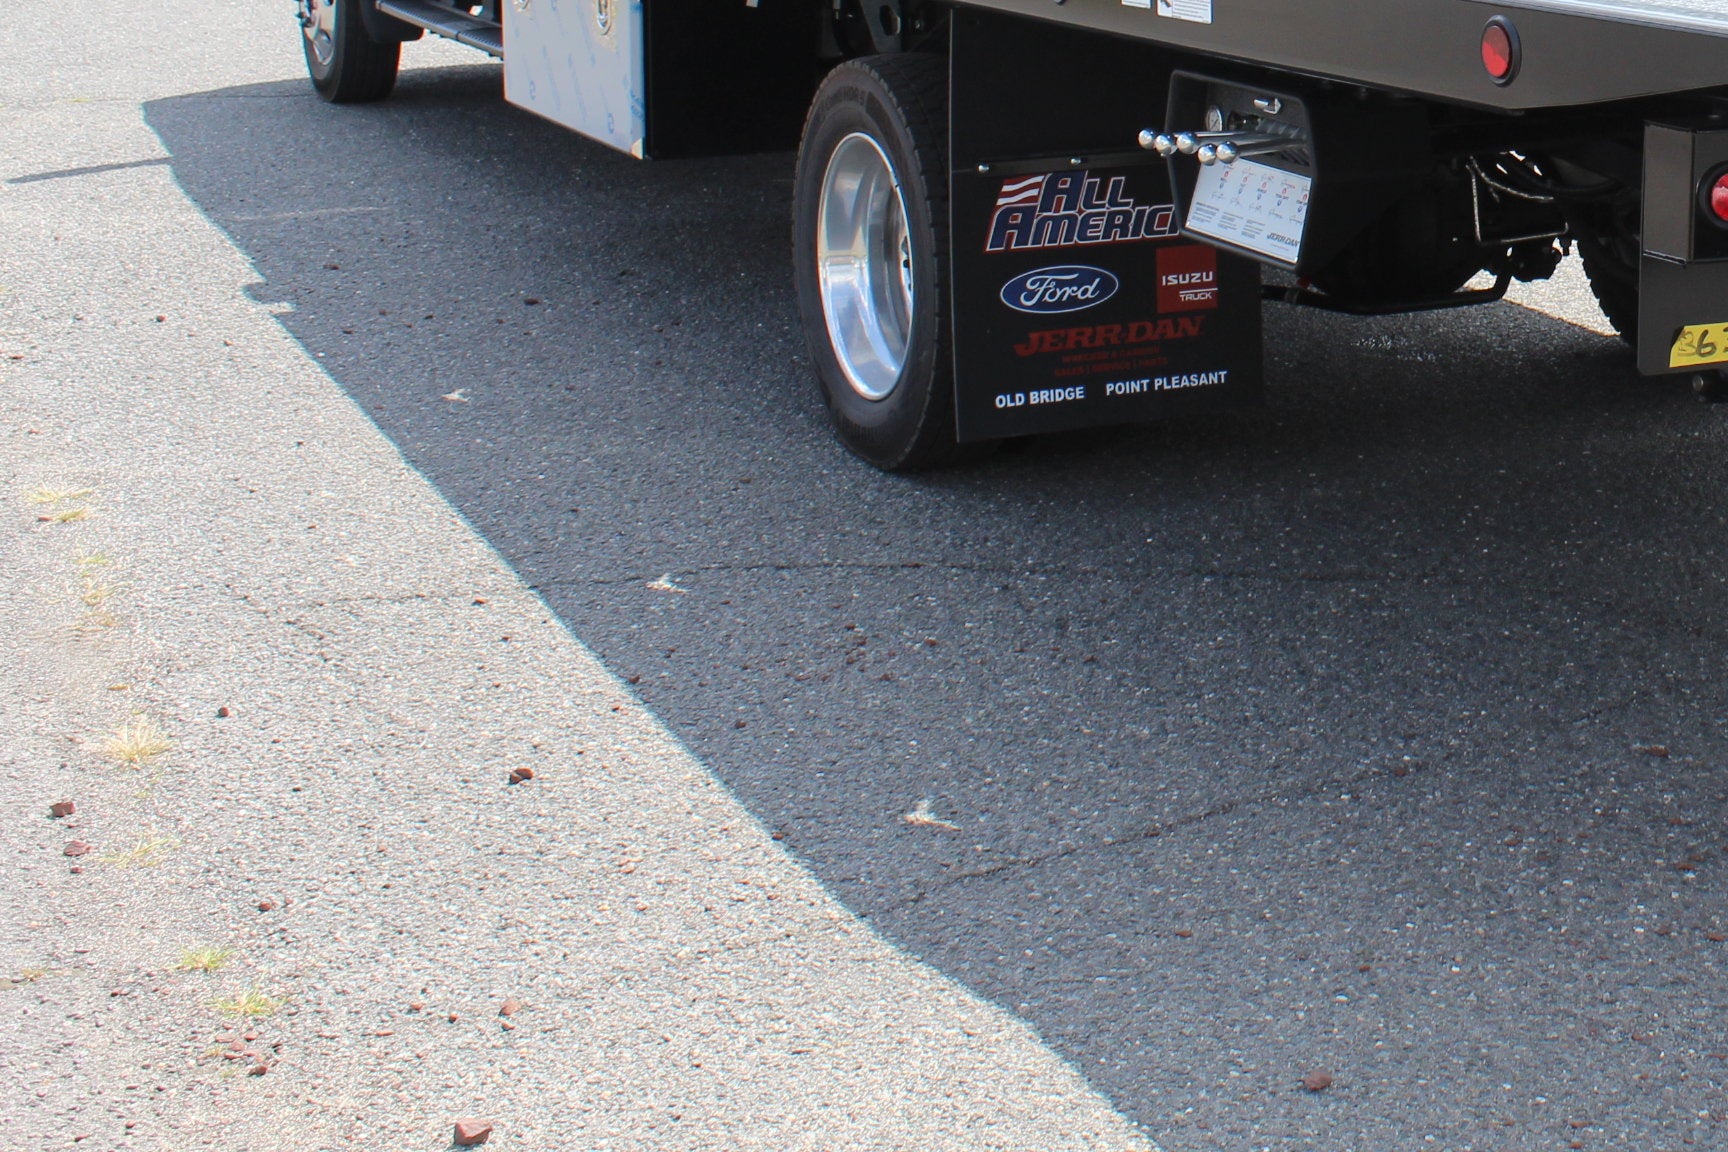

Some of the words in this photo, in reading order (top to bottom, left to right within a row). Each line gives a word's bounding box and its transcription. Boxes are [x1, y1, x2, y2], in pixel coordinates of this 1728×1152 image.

[1037, 170, 1134, 215] ALL
[1020, 273, 1101, 306] Ford
[1162, 271, 1213, 286] ISUZU
[1180, 292, 1212, 302] TRUCK
[995, 393, 1025, 409] OLD
[1029, 386, 1085, 405] BRIDGE
[1106, 379, 1150, 396] POINT
[1154, 370, 1227, 391] PLEASANT
